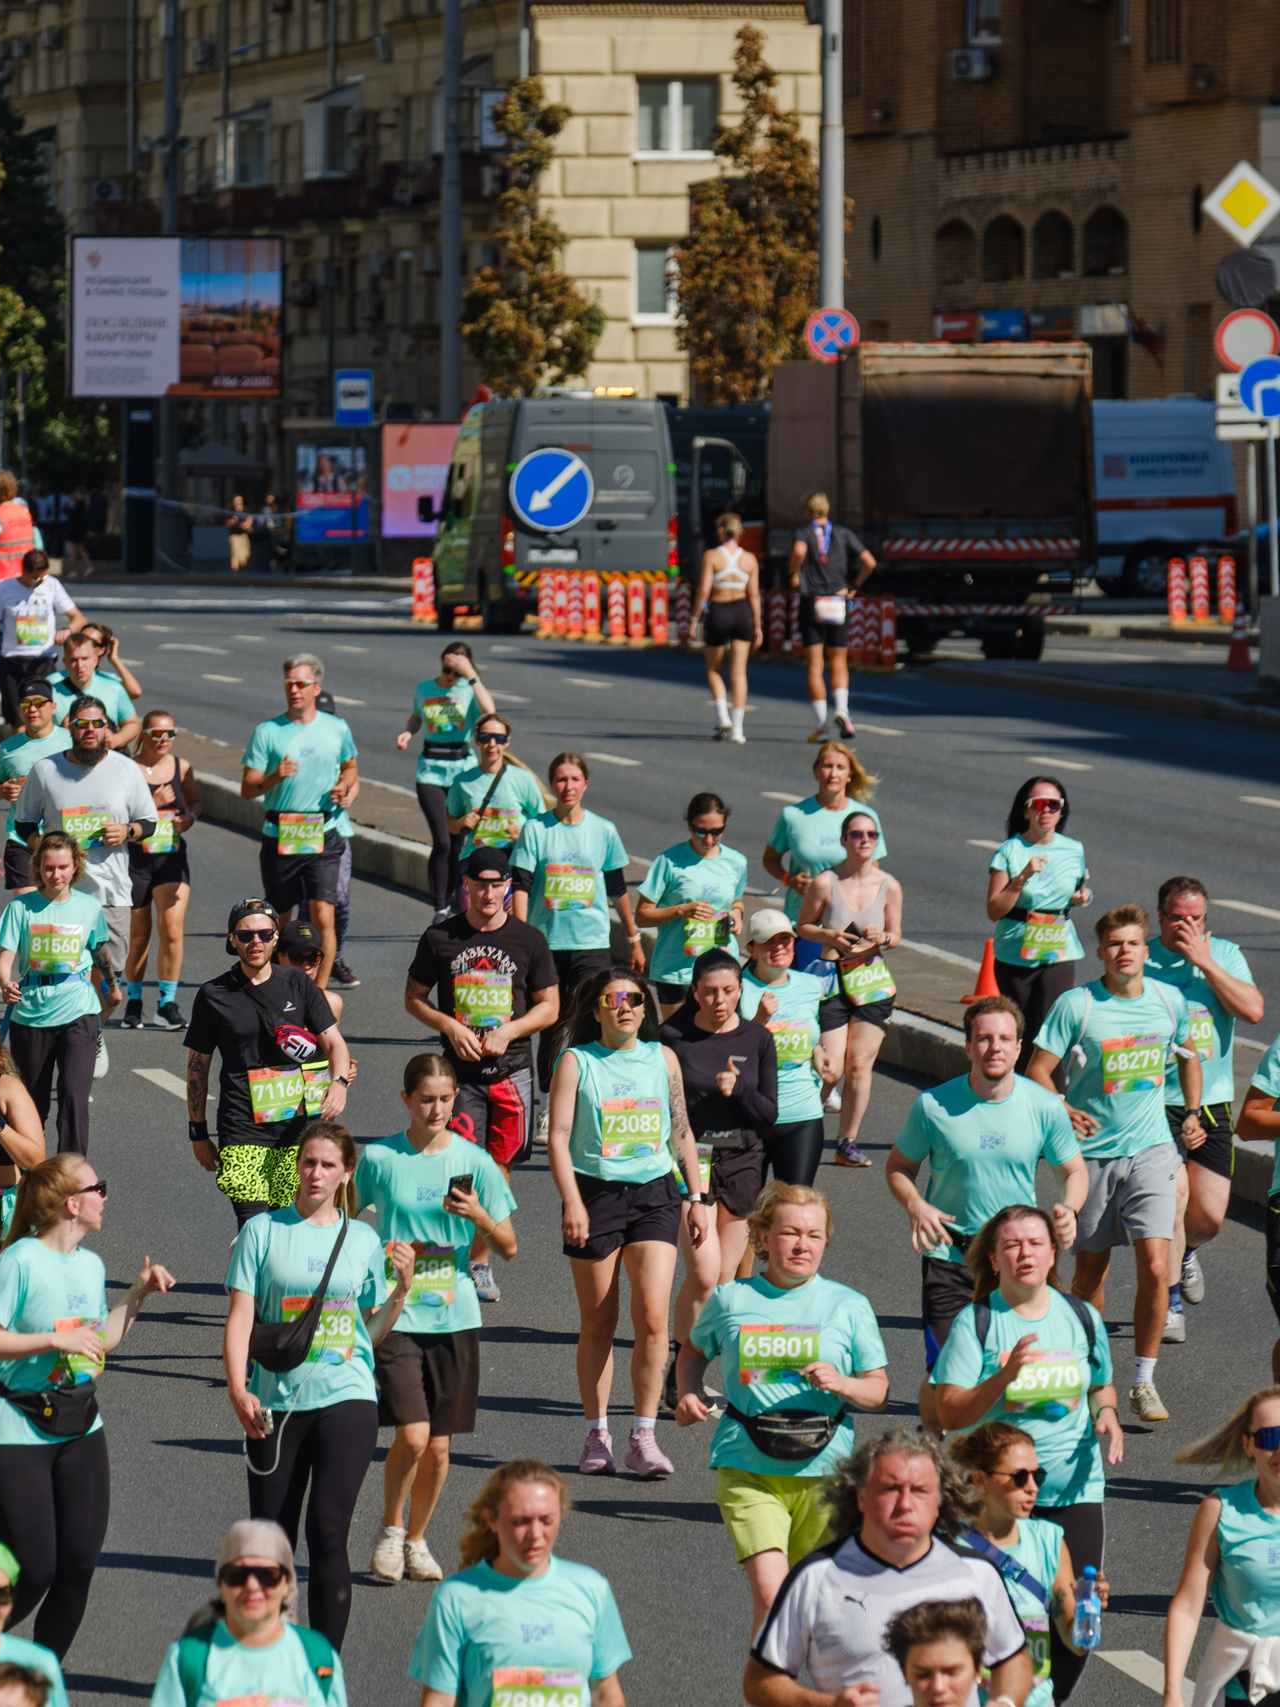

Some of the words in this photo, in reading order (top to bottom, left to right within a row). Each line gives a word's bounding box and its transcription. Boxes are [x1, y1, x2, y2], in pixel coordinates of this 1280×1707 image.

[280, 824, 323, 838] 79434
[547, 876, 594, 893] 77389
[32, 936, 80, 954] 81560
[456, 988, 510, 1006] 76333
[1106, 1048, 1161, 1074] 68279
[253, 1078, 303, 1102] 71166
[604, 1114, 661, 1134] 73083
[743, 1336, 814, 1359] 65801
